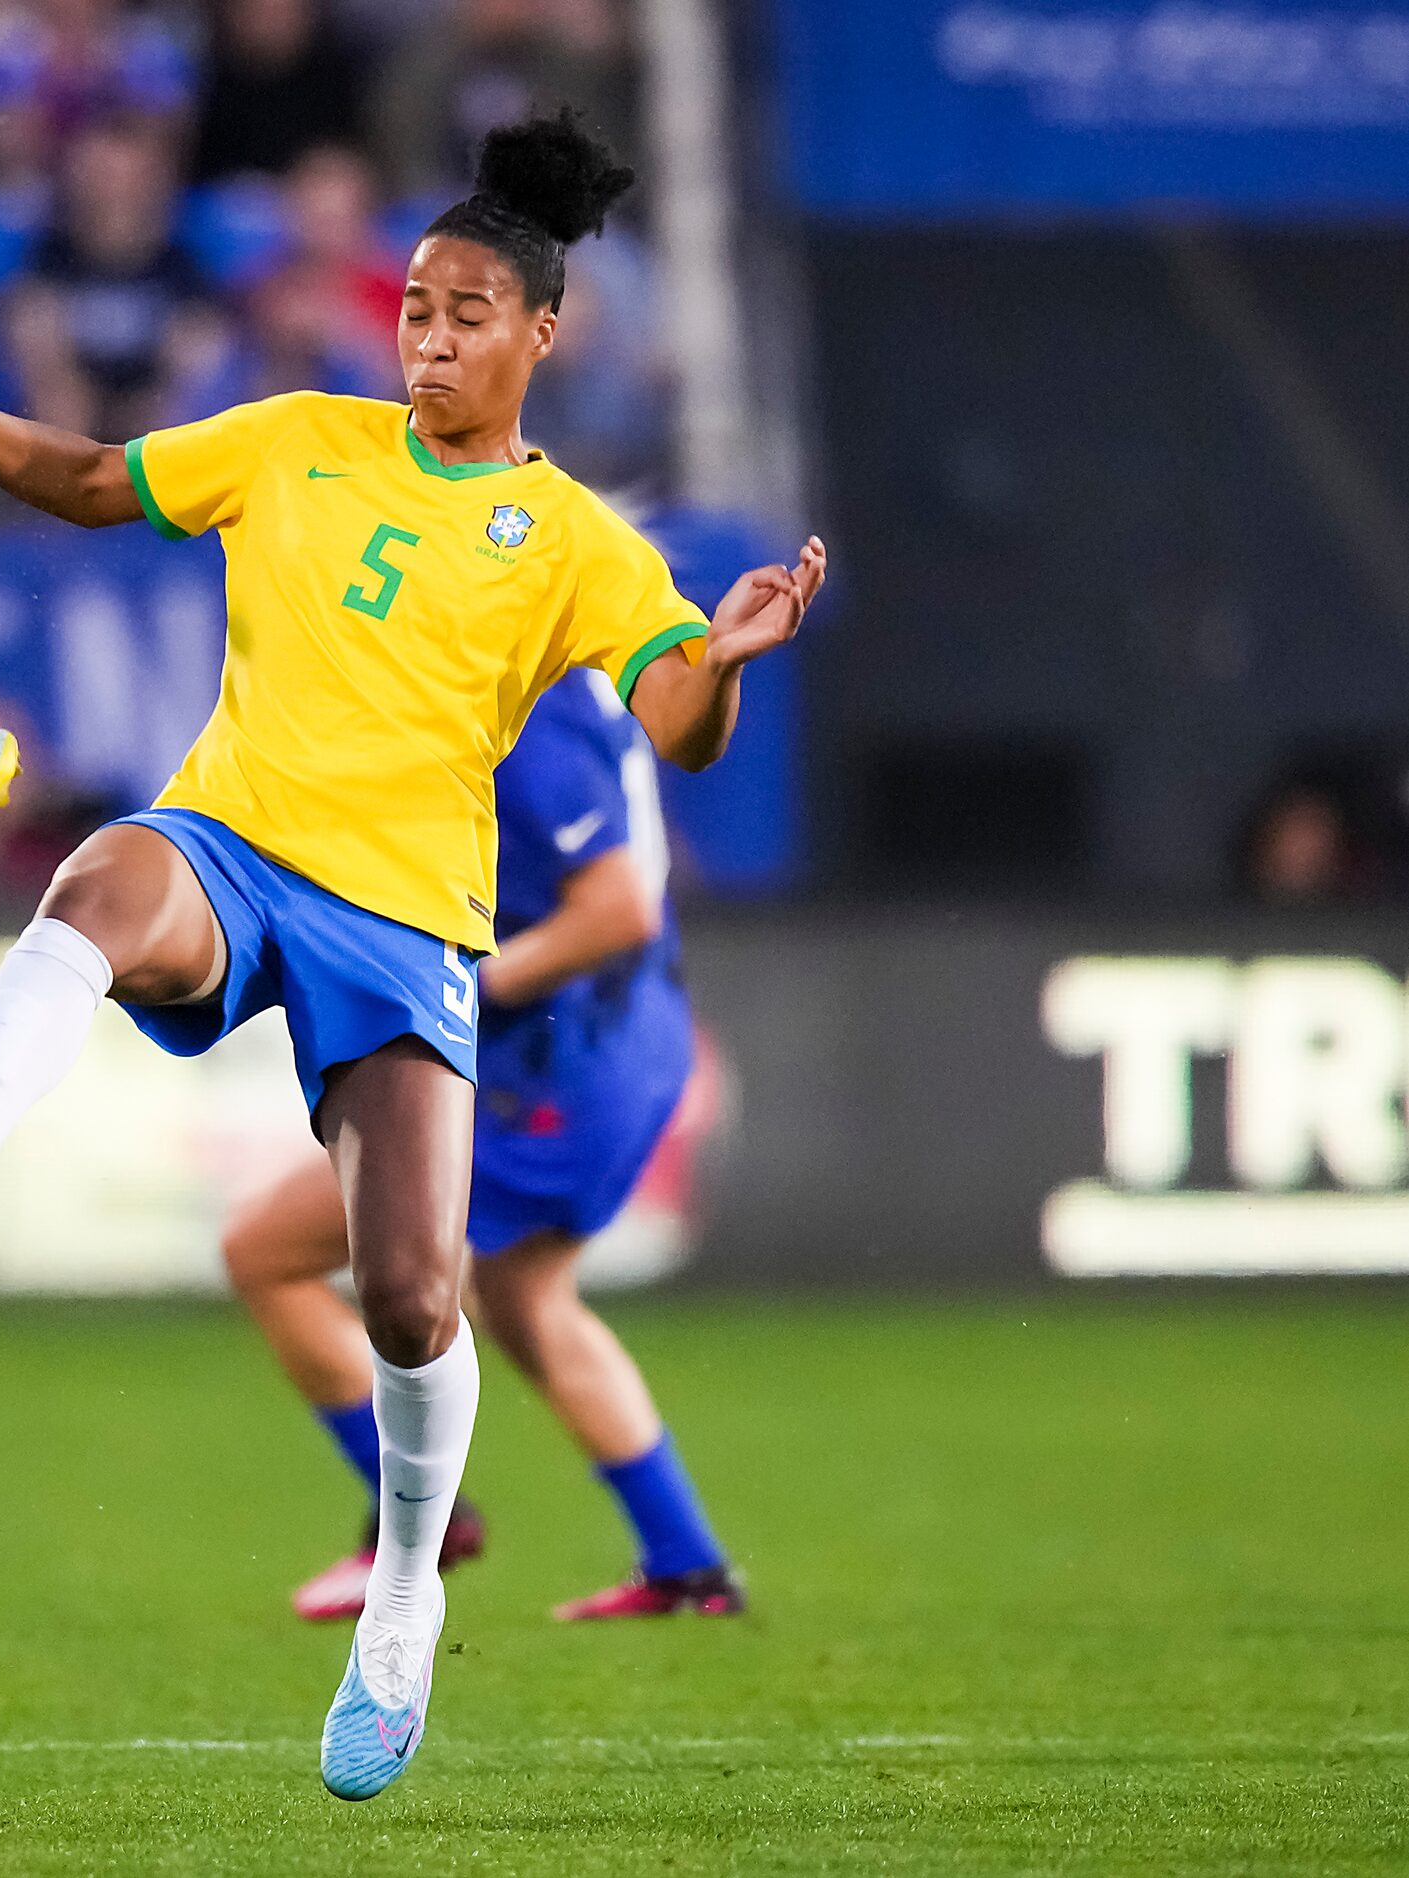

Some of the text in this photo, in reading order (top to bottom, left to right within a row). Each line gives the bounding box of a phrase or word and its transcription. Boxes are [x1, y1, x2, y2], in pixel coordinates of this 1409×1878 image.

[342, 523, 422, 621] 5
[443, 940, 475, 1029] 5
[1041, 953, 1409, 1190] TR
